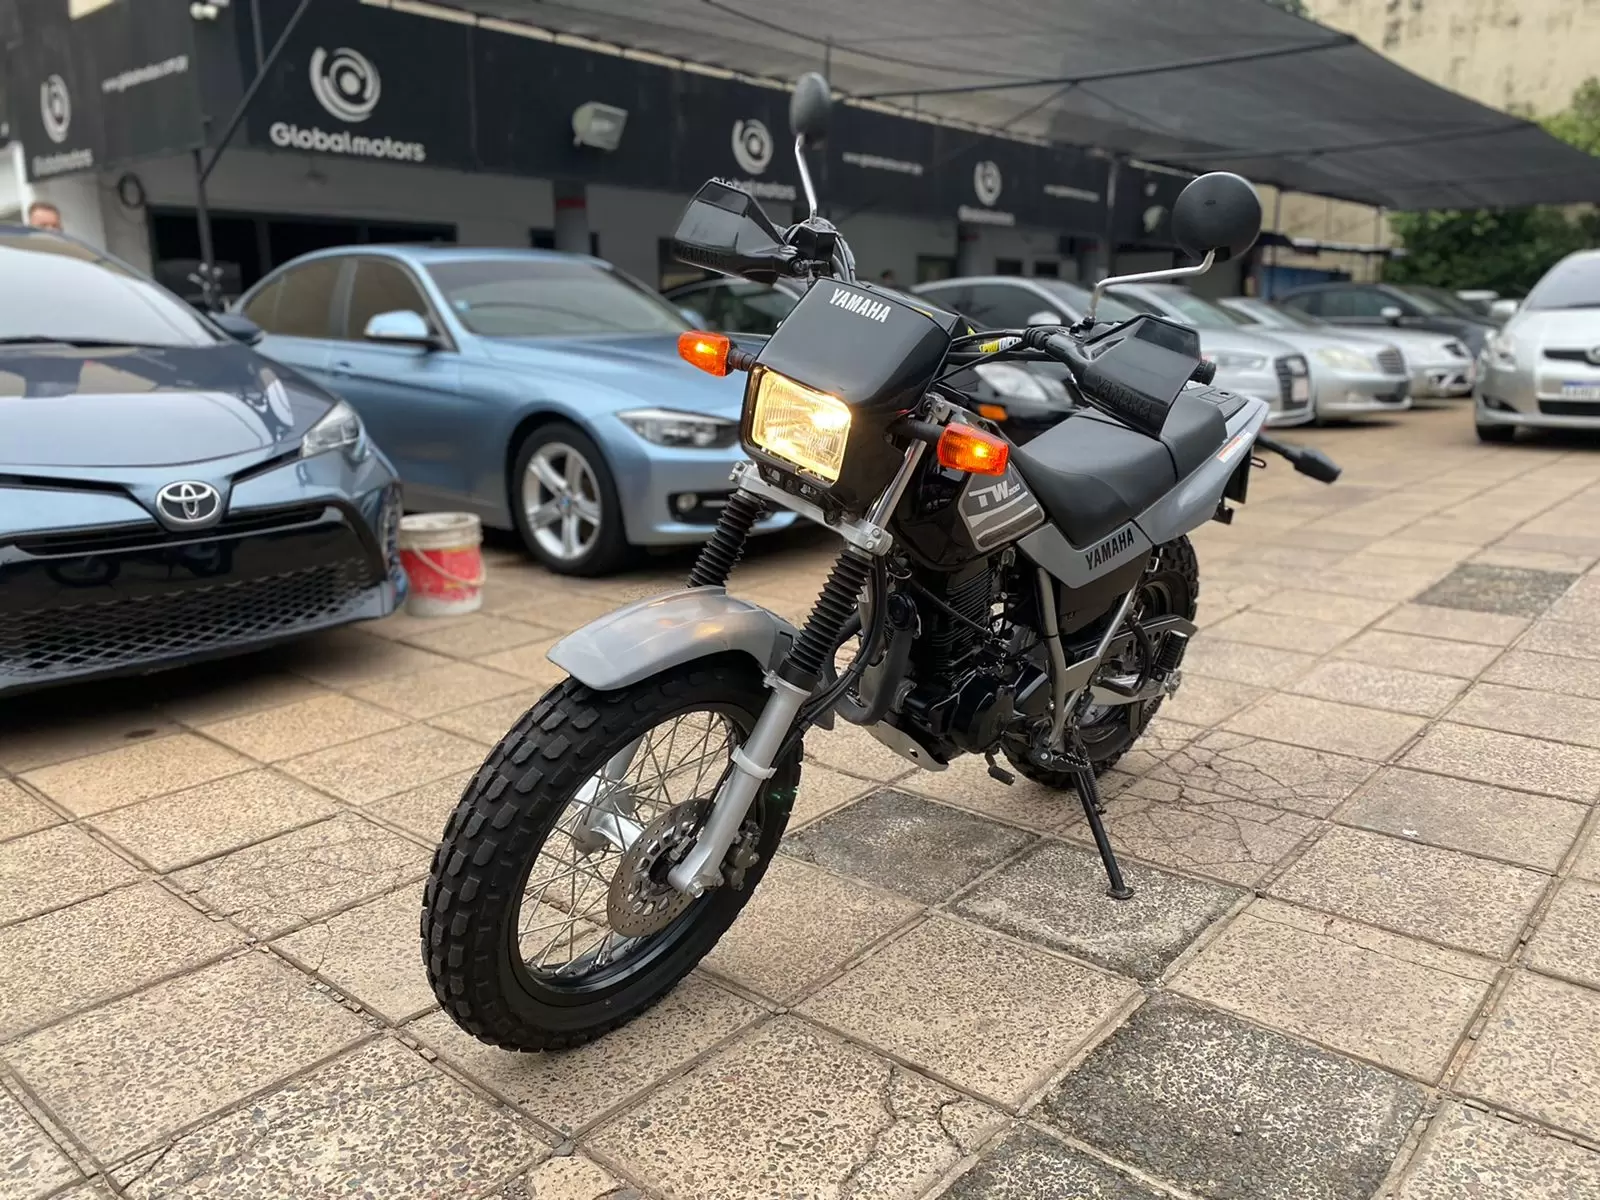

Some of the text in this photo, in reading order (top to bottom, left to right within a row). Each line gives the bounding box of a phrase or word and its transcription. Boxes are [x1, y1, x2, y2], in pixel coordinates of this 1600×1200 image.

[269, 121, 426, 162] Globalmotors
[829, 288, 892, 323] YAMAHA
[1085, 527, 1136, 571] YAMAHA
